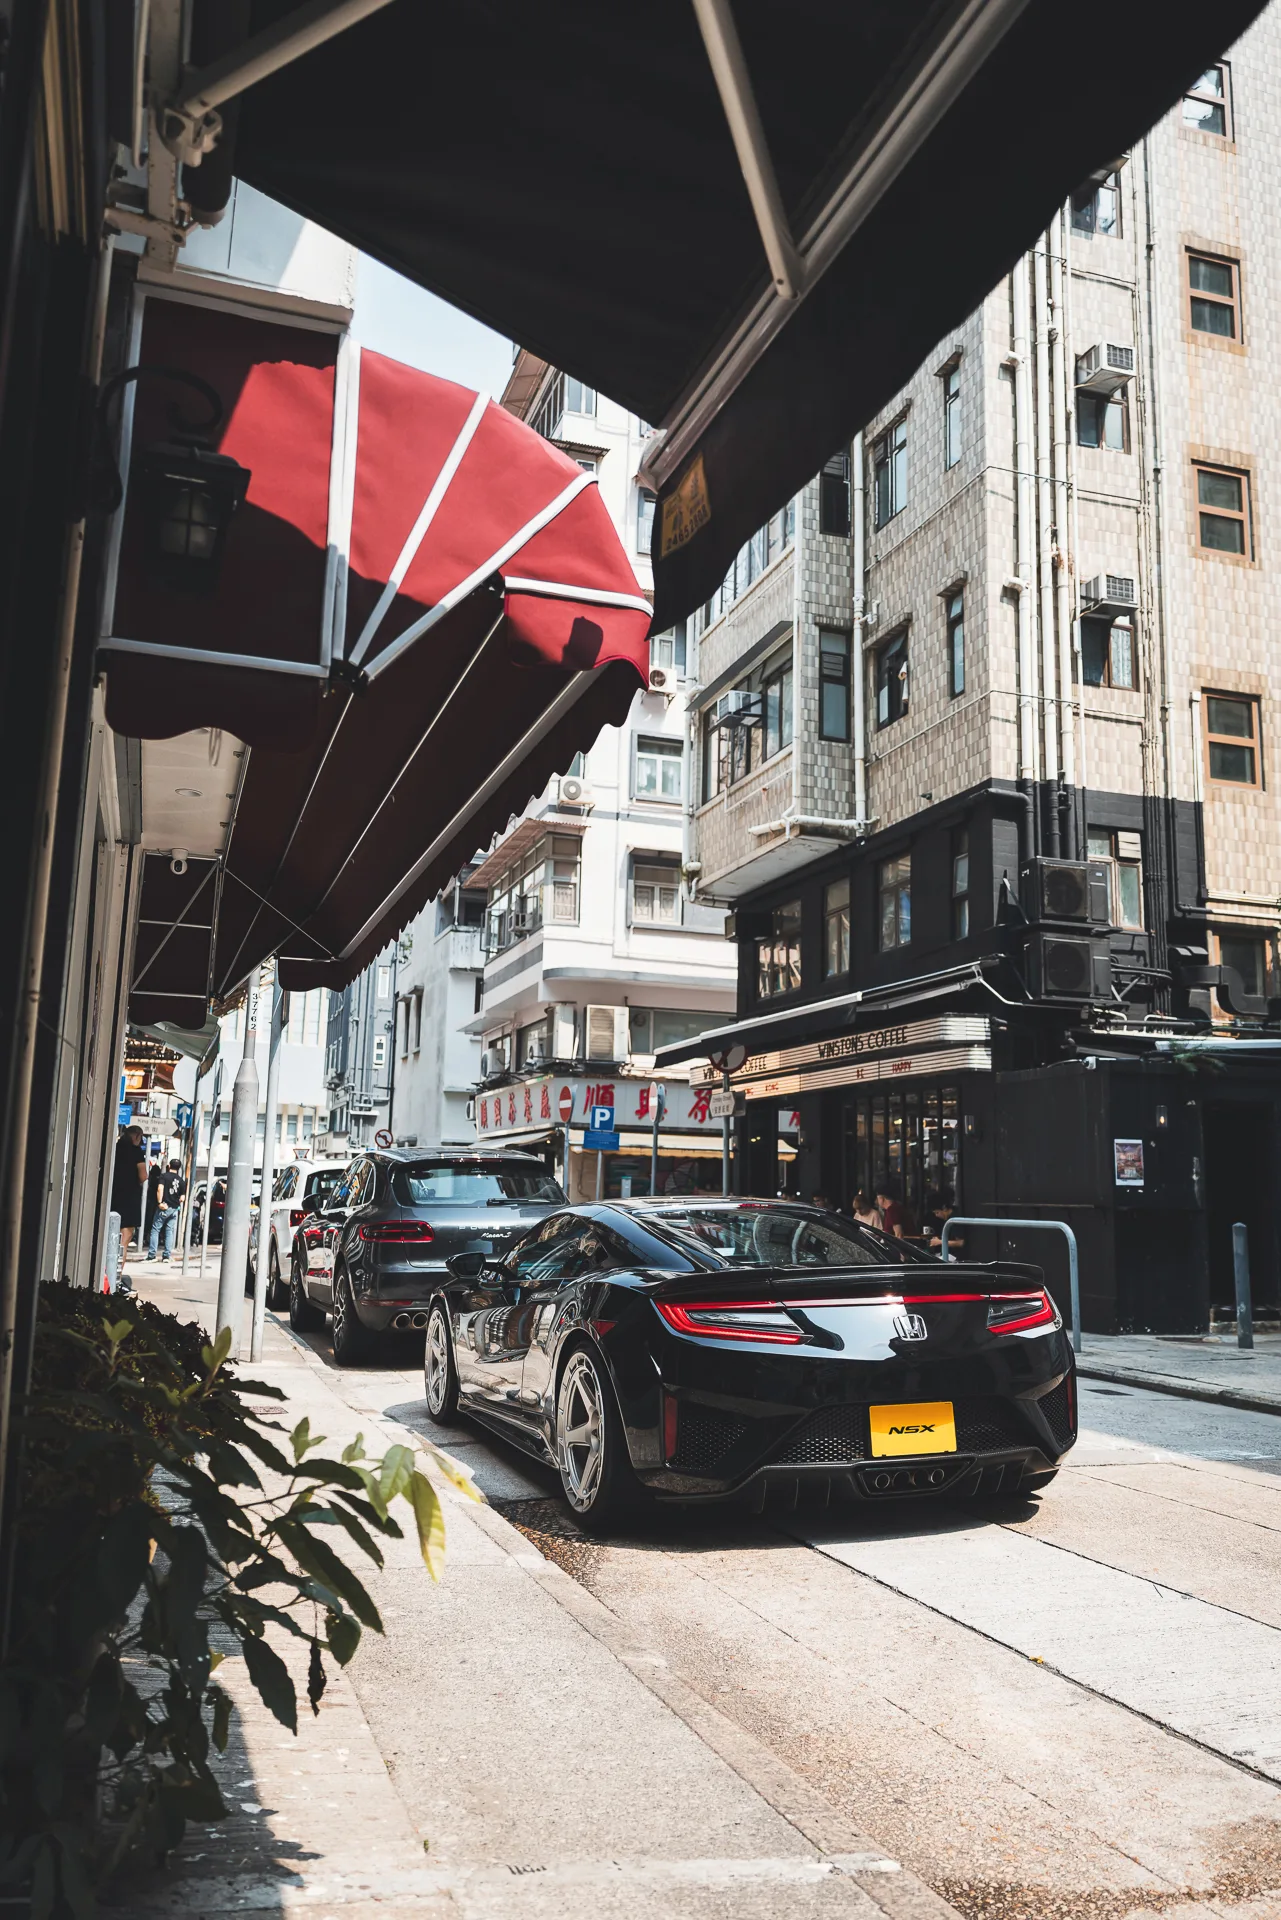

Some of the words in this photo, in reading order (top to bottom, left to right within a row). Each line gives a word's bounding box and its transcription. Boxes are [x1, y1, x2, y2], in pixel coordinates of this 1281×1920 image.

[250, 992, 259, 1031] 37762
[867, 1025, 908, 1050] COFFEE
[594, 1108, 611, 1129] P
[888, 1424, 936, 1435] NSX
